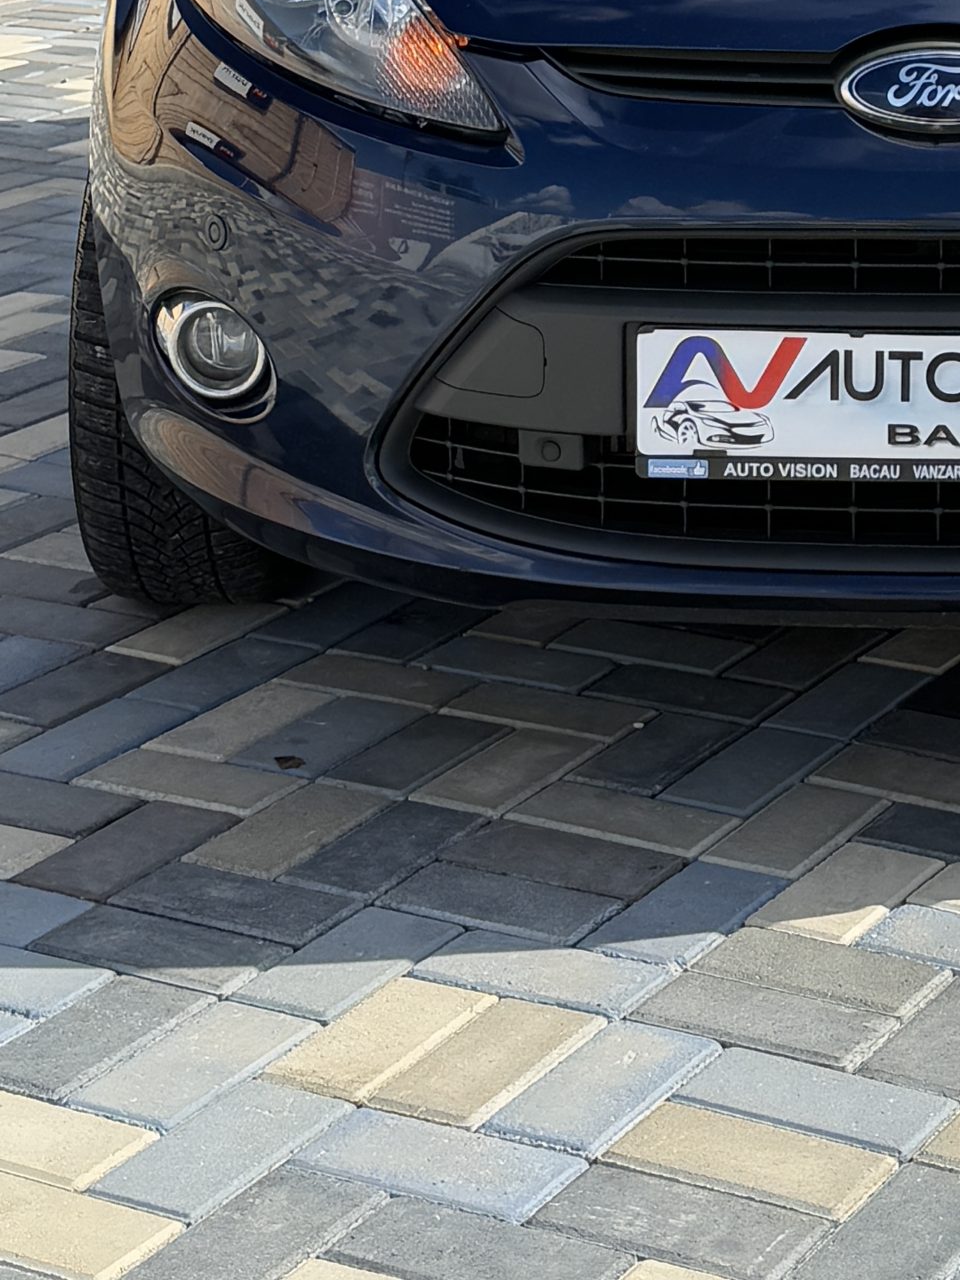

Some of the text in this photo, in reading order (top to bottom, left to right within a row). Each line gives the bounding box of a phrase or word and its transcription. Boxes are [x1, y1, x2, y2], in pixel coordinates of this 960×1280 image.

[723, 462, 774, 478] AUTO
[778, 463, 838, 479] VISION
[850, 464, 900, 480] BACAU
